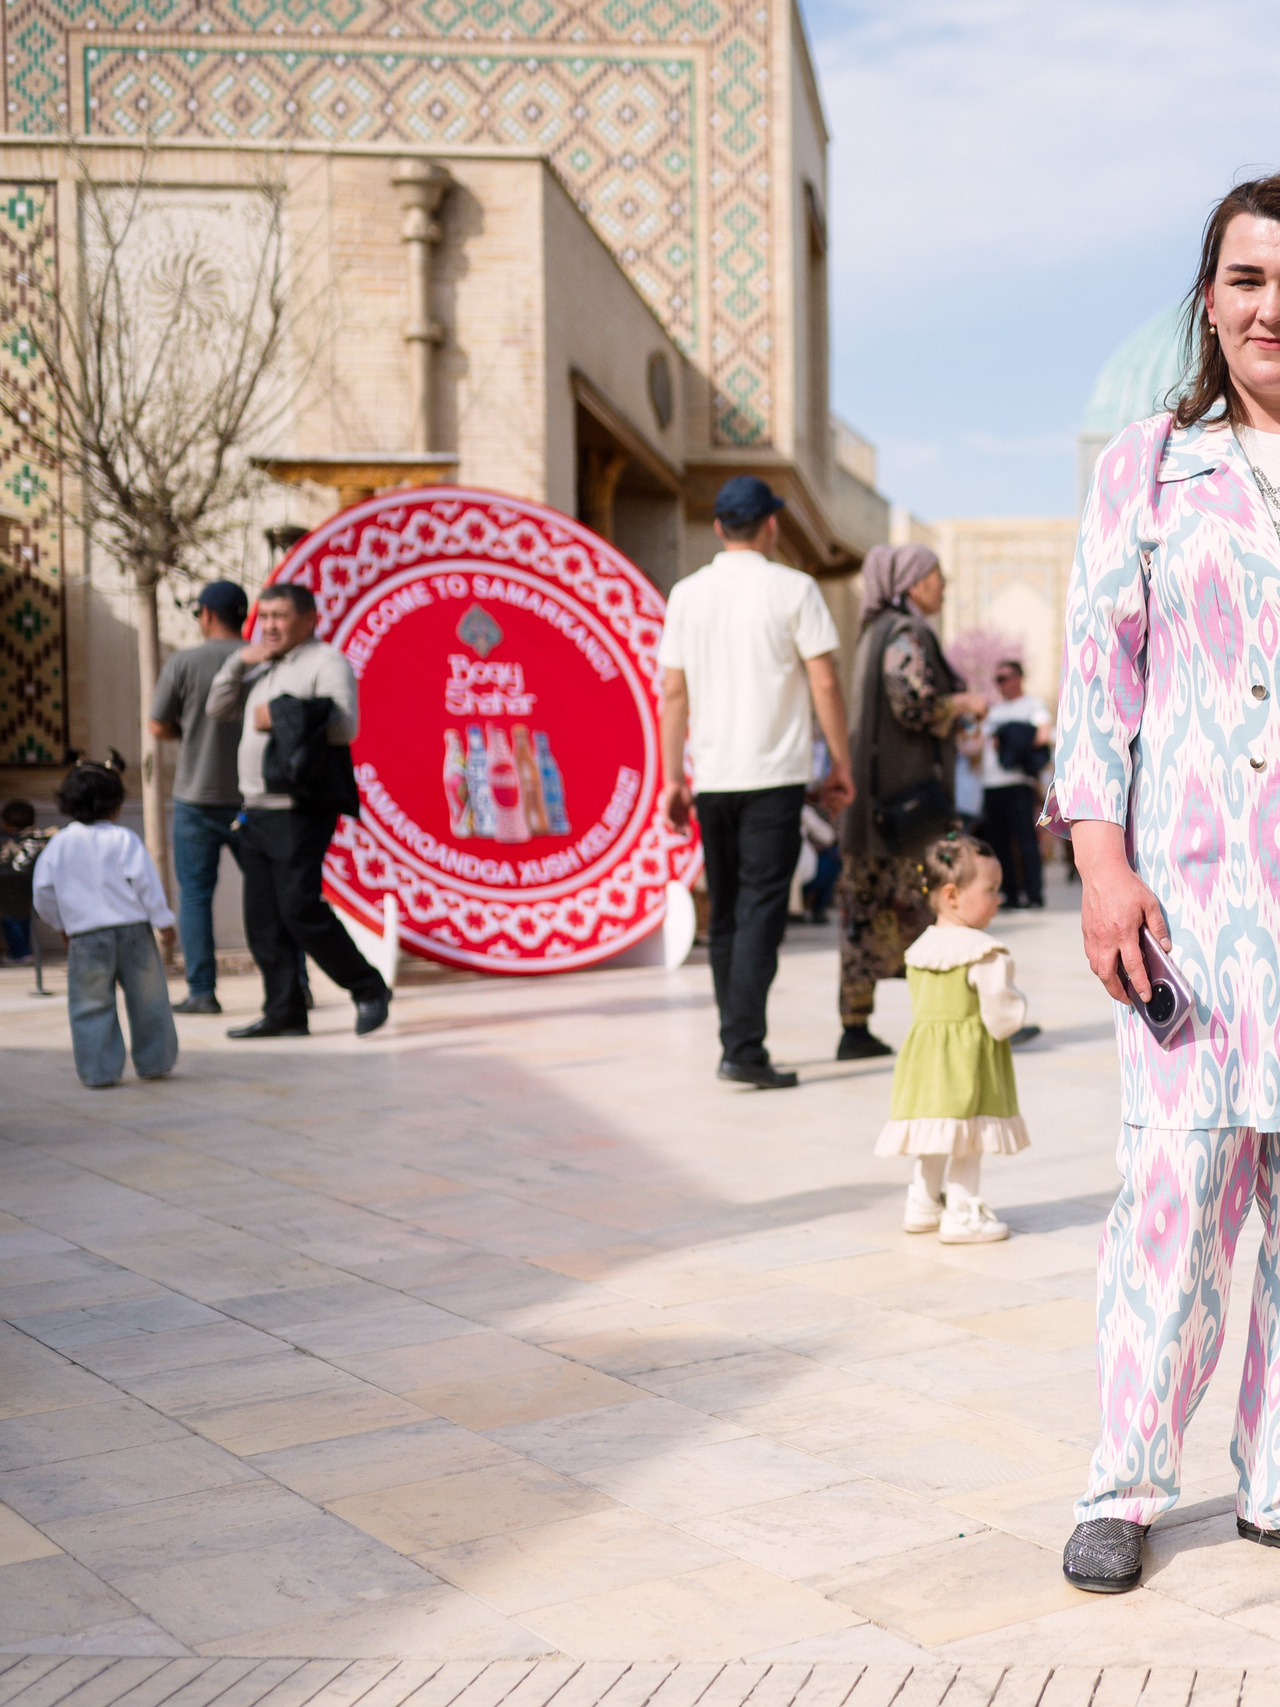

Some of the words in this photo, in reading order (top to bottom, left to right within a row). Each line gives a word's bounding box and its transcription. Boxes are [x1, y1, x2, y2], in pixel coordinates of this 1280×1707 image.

[430, 574, 469, 600] TO
[472, 574, 619, 682] SAMARKAND!
[353, 762, 517, 886] SAMARQANDGA
[517, 846, 582, 886] XUSH
